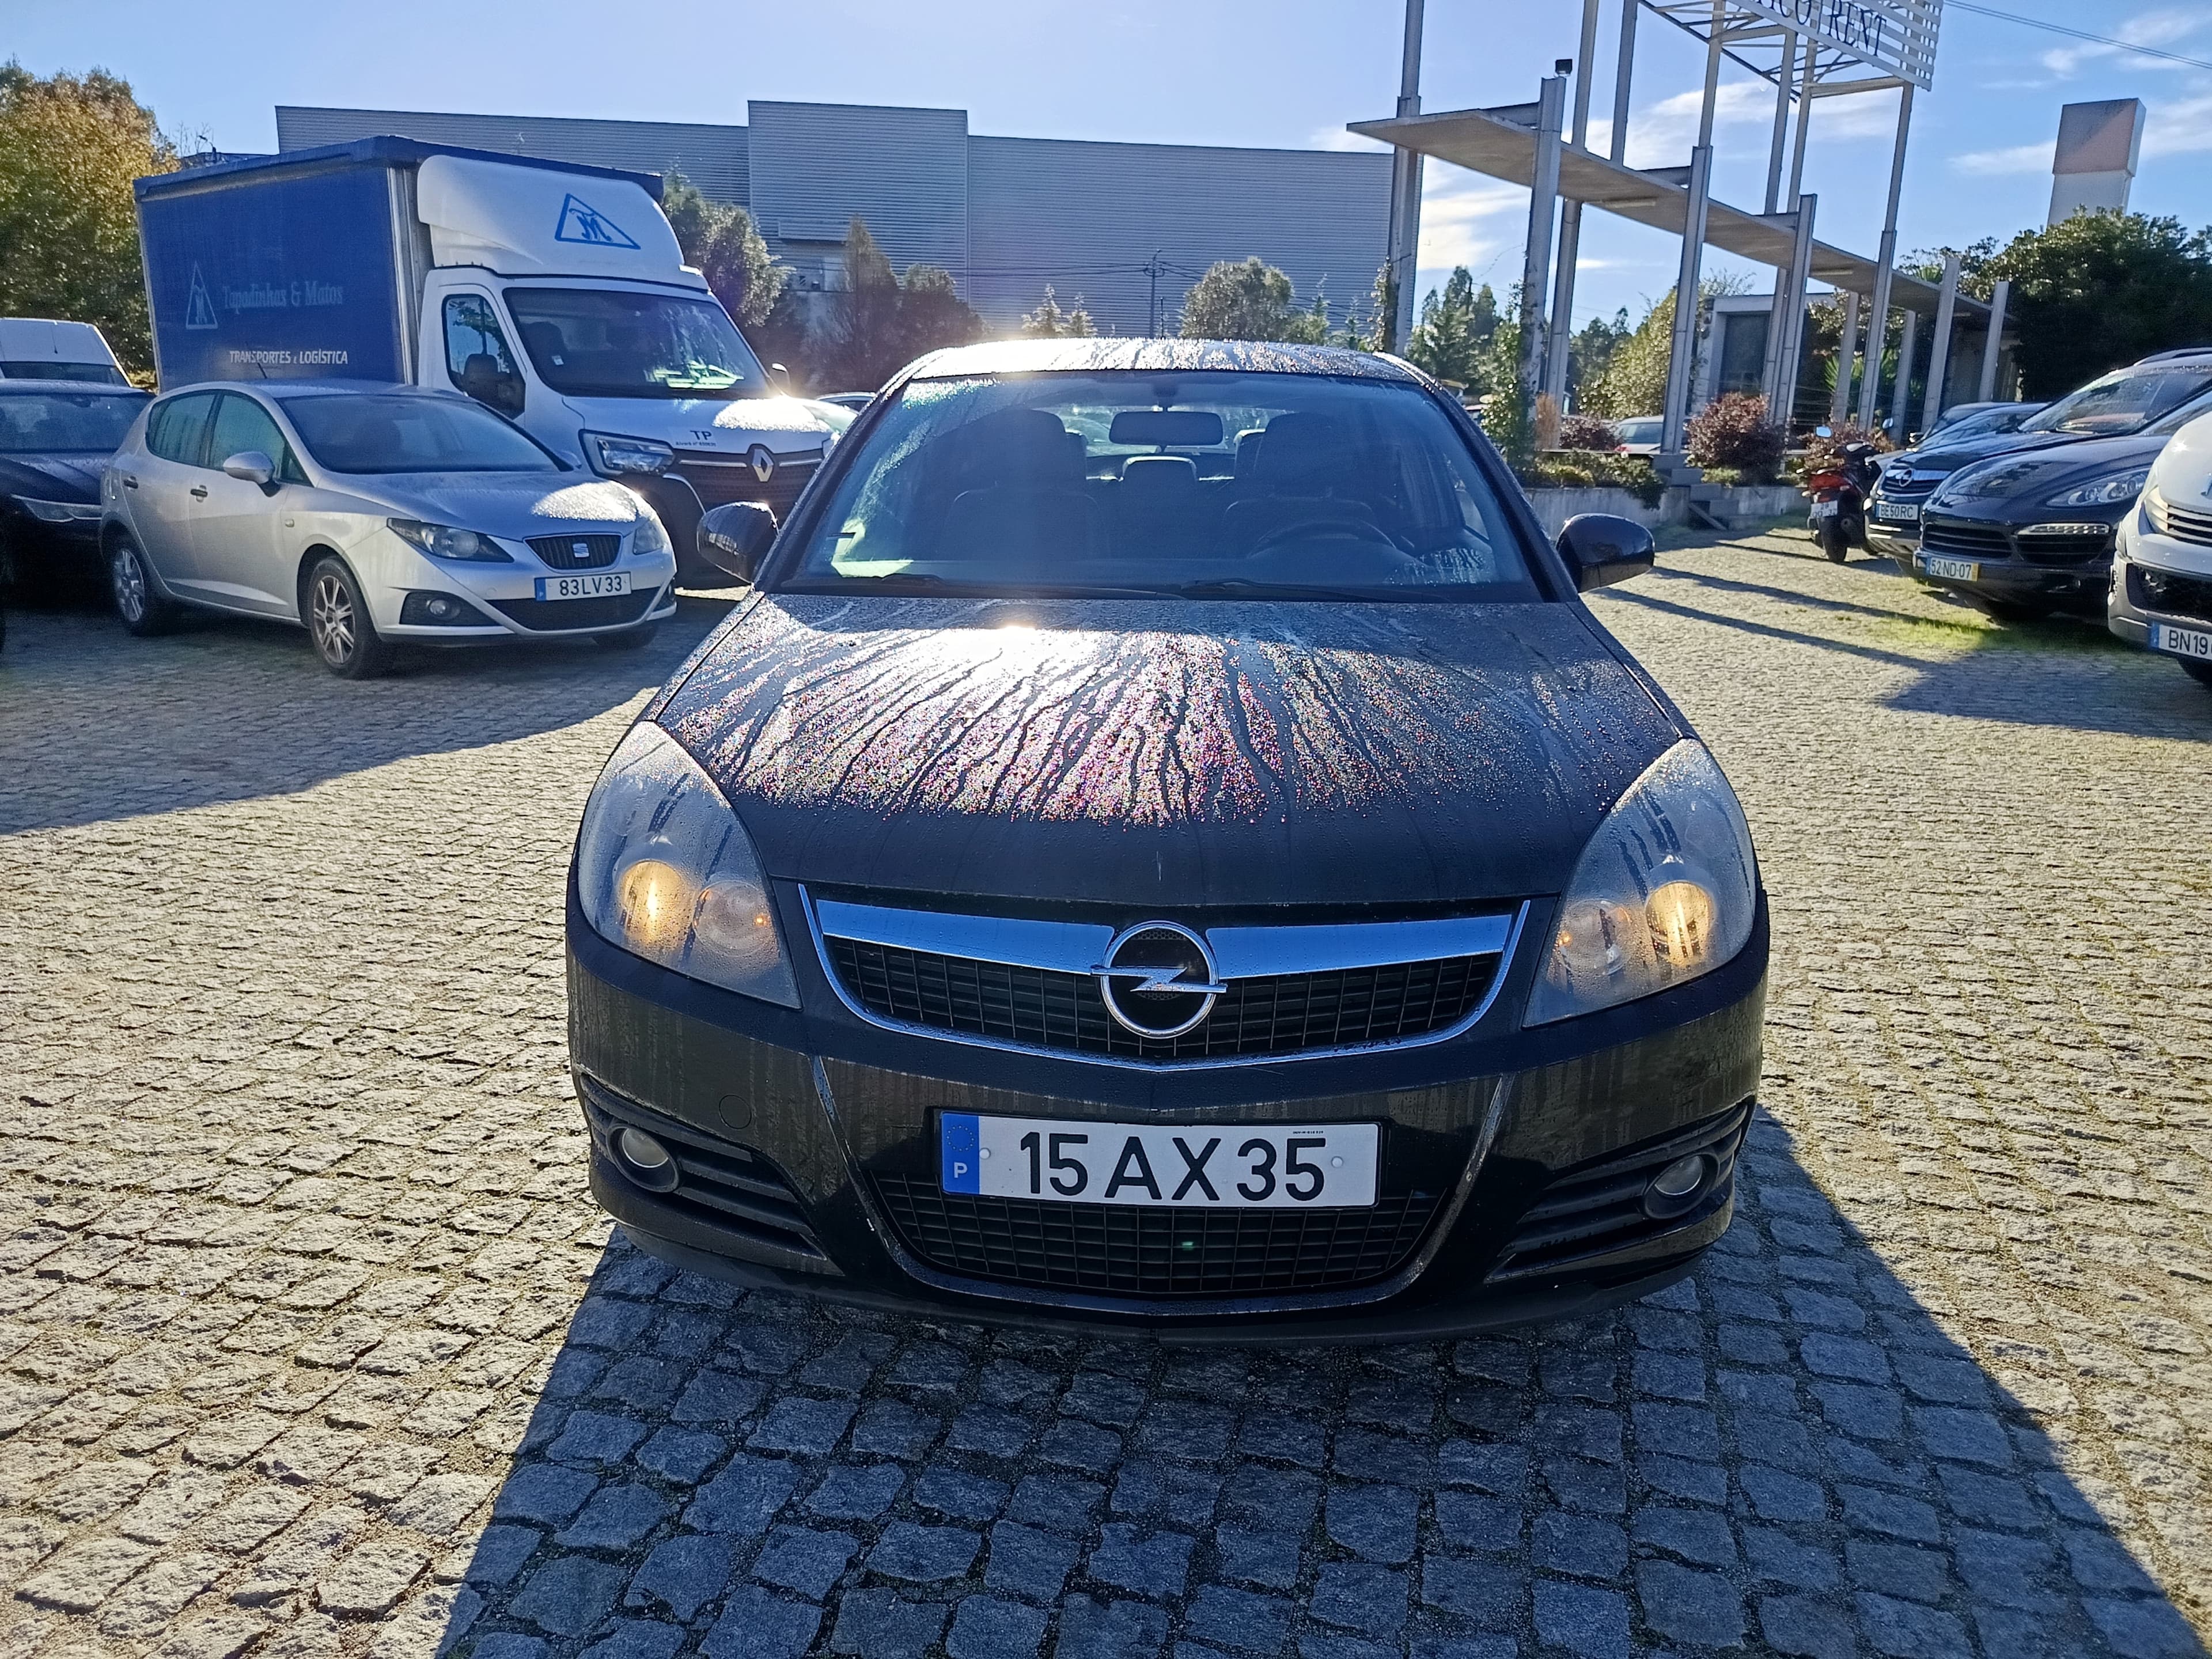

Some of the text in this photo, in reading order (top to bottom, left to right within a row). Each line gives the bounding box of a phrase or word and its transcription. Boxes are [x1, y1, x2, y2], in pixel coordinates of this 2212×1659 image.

[1827, 0, 1887, 56] RENT
[305, 281, 344, 306] Matos
[230, 350, 291, 364] TRANSPORTES
[300, 349, 348, 365] LOGÍSTICA
[690, 430, 712, 440] TP
[954, 1161, 968, 1178] P
